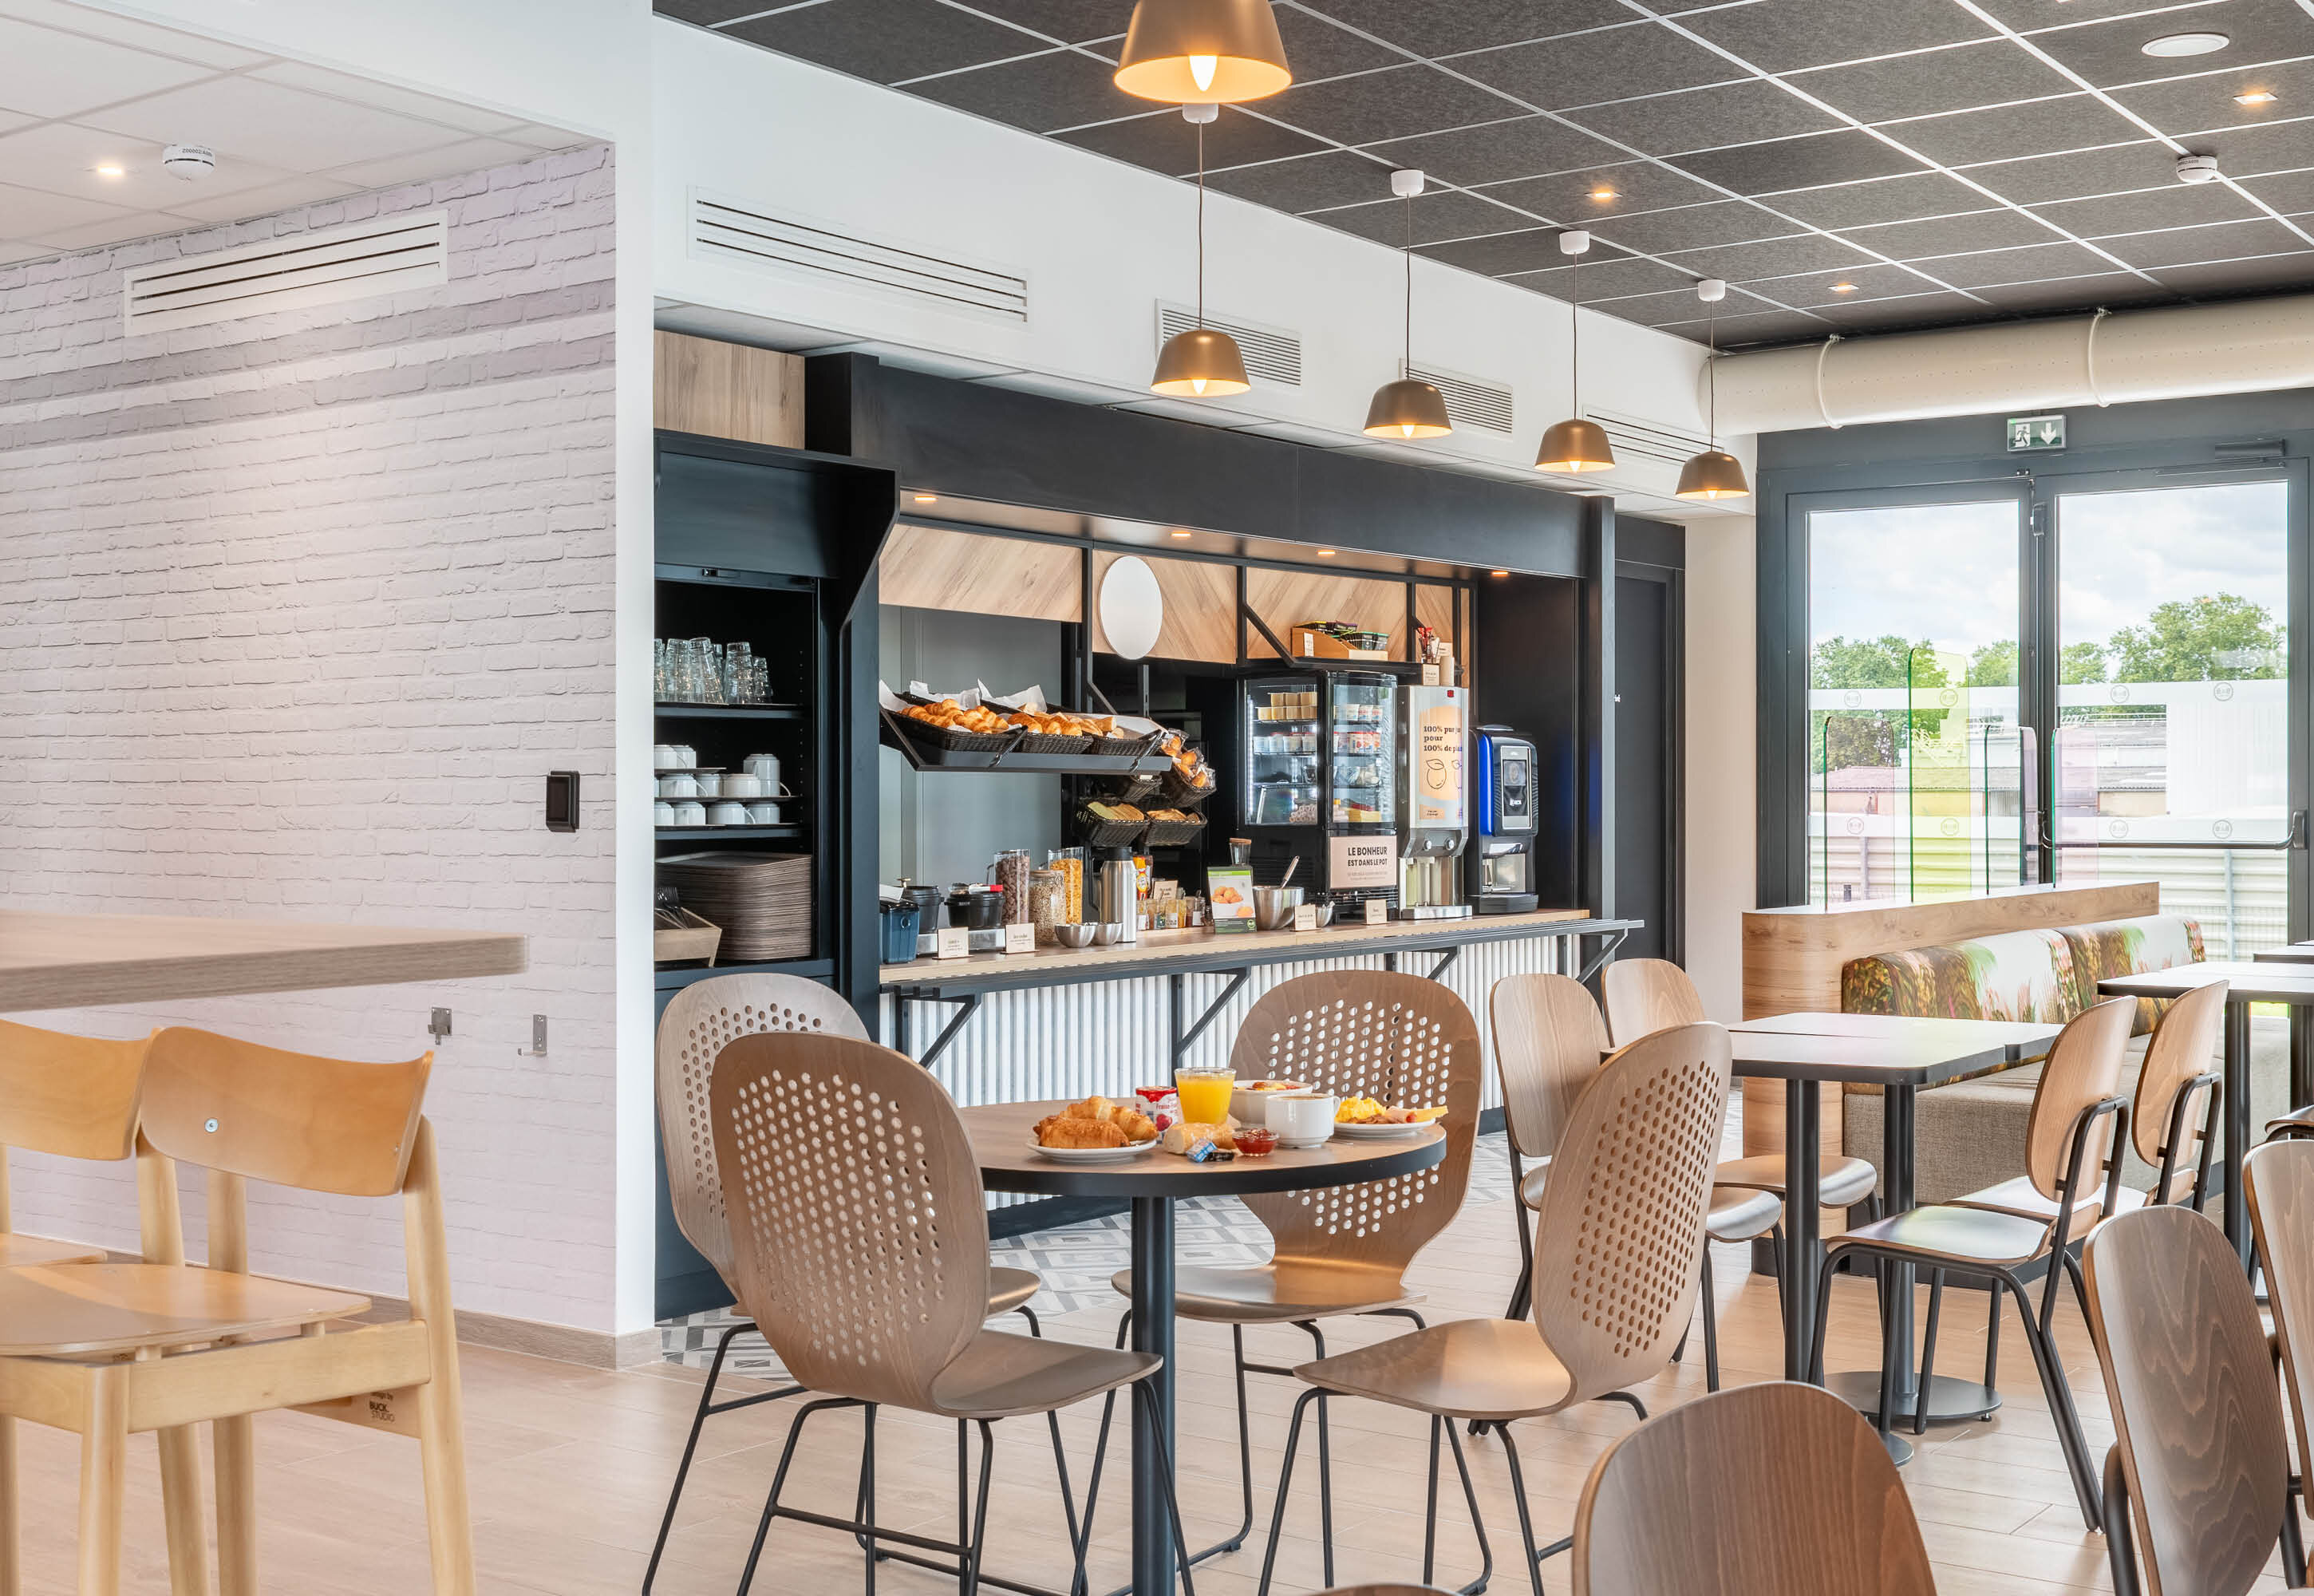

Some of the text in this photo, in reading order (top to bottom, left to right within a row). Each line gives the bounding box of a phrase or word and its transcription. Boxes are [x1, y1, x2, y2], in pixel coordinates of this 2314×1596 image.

[1348, 846, 1388, 856] LE BONHEUR
[371, 1410, 395, 1423] STUDIO
